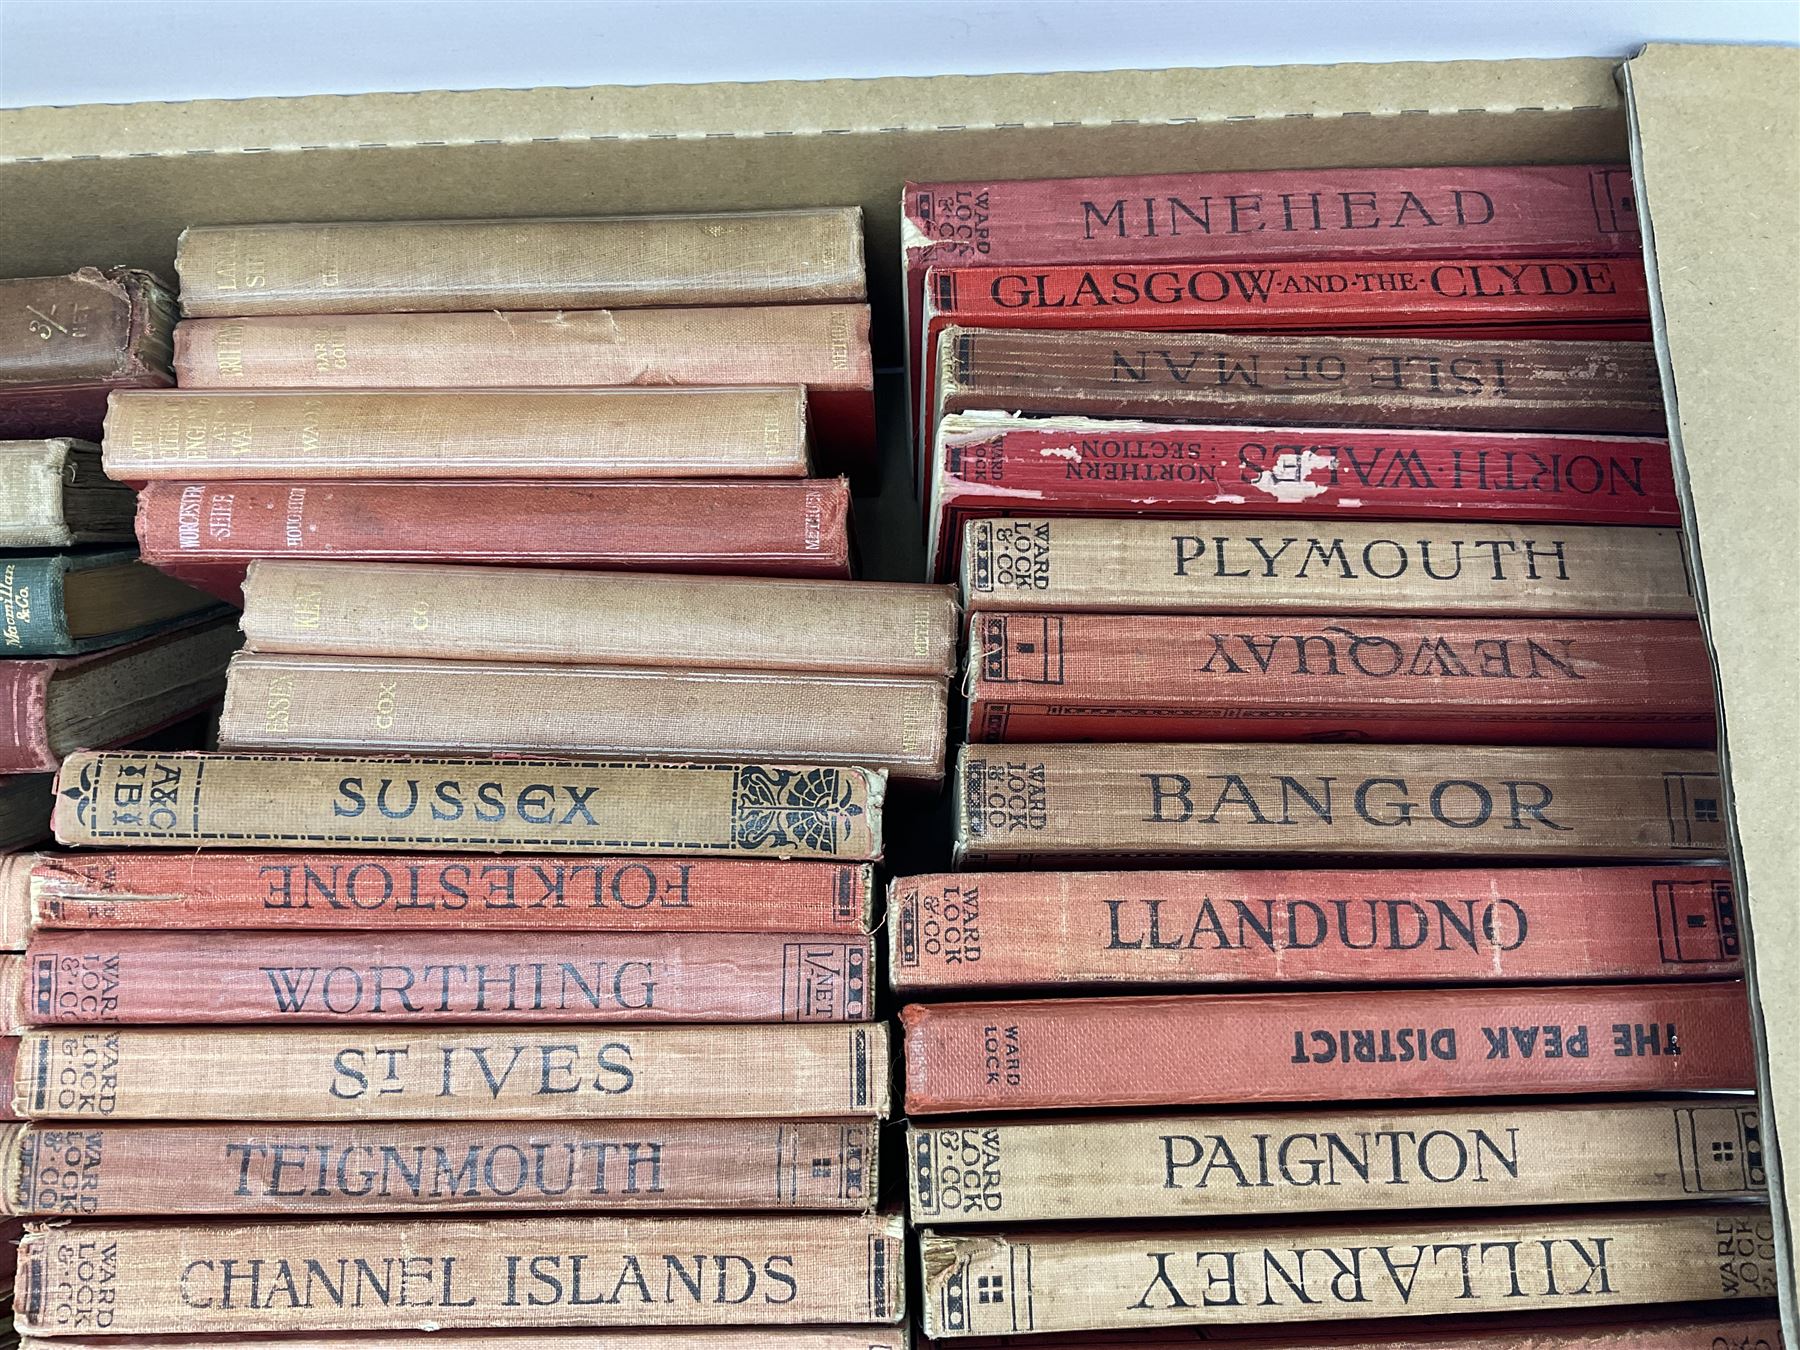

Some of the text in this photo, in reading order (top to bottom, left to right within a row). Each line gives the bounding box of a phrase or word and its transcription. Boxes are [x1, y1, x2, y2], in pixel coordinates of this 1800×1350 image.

[974, 191, 991, 255] WARD
[1080, 189, 1497, 240] MINEHEAD
[1430, 262, 1617, 298] CLYDE
[1111, 349, 1508, 395] ISLE OF MAN
[1064, 461, 1217, 483] NORTHERN
[1081, 439, 1202, 460] SECTION
[179, 484, 206, 549] WORCESTER
[804, 490, 820, 550] METHUEN
[1014, 521, 1032, 591] LOCK
[1033, 521, 1050, 591] WARD
[1171, 535, 1571, 582] PLYMOUTH
[3, 563, 16, 649] Macmillan
[1199, 625, 1586, 680] NEWQUAY
[376, 681, 399, 730] COX
[333, 776, 601, 826] SUSSEX
[1007, 762, 1028, 831] LOCK
[1027, 762, 1047, 831] WARD
[1140, 772, 1574, 832] BANGOR
[259, 863, 696, 911] FOLKESTONE
[943, 886, 963, 965] LOCK
[962, 886, 981, 963] WARD
[1102, 895, 1529, 955] LLANDUDNO
[81, 954, 100, 1020] LOC
[101, 952, 120, 1020] WAR
[258, 961, 658, 1014] WORTHING
[79, 1034, 98, 1113] LOCK
[99, 1030, 122, 1117] WARD
[437, 1042, 635, 1099] IVES
[984, 1026, 999, 1085] LOCK
[1004, 1026, 1020, 1086] WARD
[1291, 1024, 1681, 1065] THE PEAK DISTRICT
[60, 1131, 83, 1214] LOCK
[80, 1131, 104, 1214] WARD
[225, 1141, 666, 1199] TEIGNMOUTH
[960, 1129, 983, 1214] LOCK
[981, 1128, 1002, 1213] WARD
[1158, 1127, 1520, 1190] PAIGNTON
[74, 1241, 96, 1330] LOCK
[97, 1240, 118, 1329] WARD
[181, 1253, 799, 1310] CHANNEL ISLANDS
[1126, 1236, 1620, 1311] KILLARNEY
